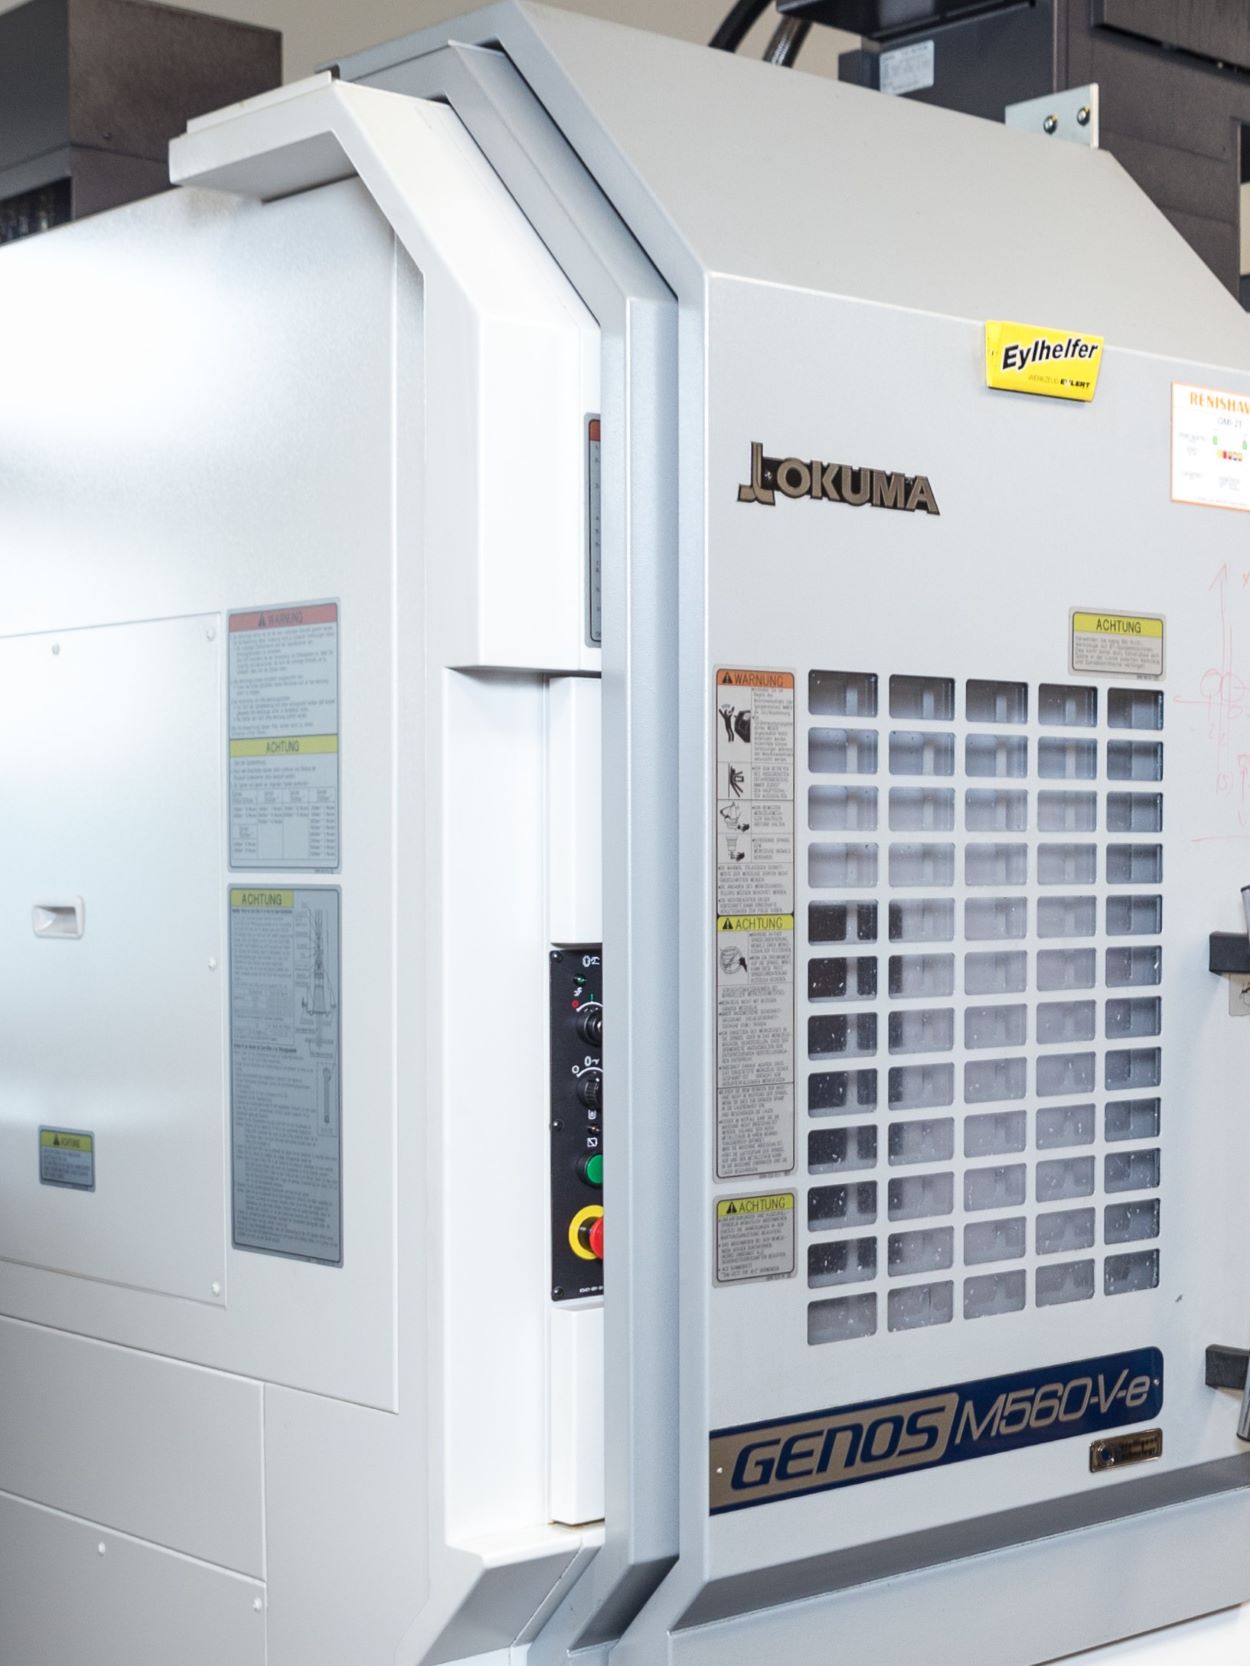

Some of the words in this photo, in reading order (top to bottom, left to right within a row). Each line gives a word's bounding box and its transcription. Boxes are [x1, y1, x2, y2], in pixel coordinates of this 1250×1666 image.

[1002, 338, 1098, 370] Eylhelfer
[776, 457, 940, 515] OKUMA
[1095, 618, 1142, 633] ACHTUNG
[734, 673, 784, 686] WARNUNG
[266, 740, 300, 753] ACHTUNG
[241, 893, 283, 906] ACHTUNG
[735, 917, 783, 930] ACHTUNG
[739, 1197, 786, 1214] ACHTUNG
[730, 1406, 946, 1491] GENOS
